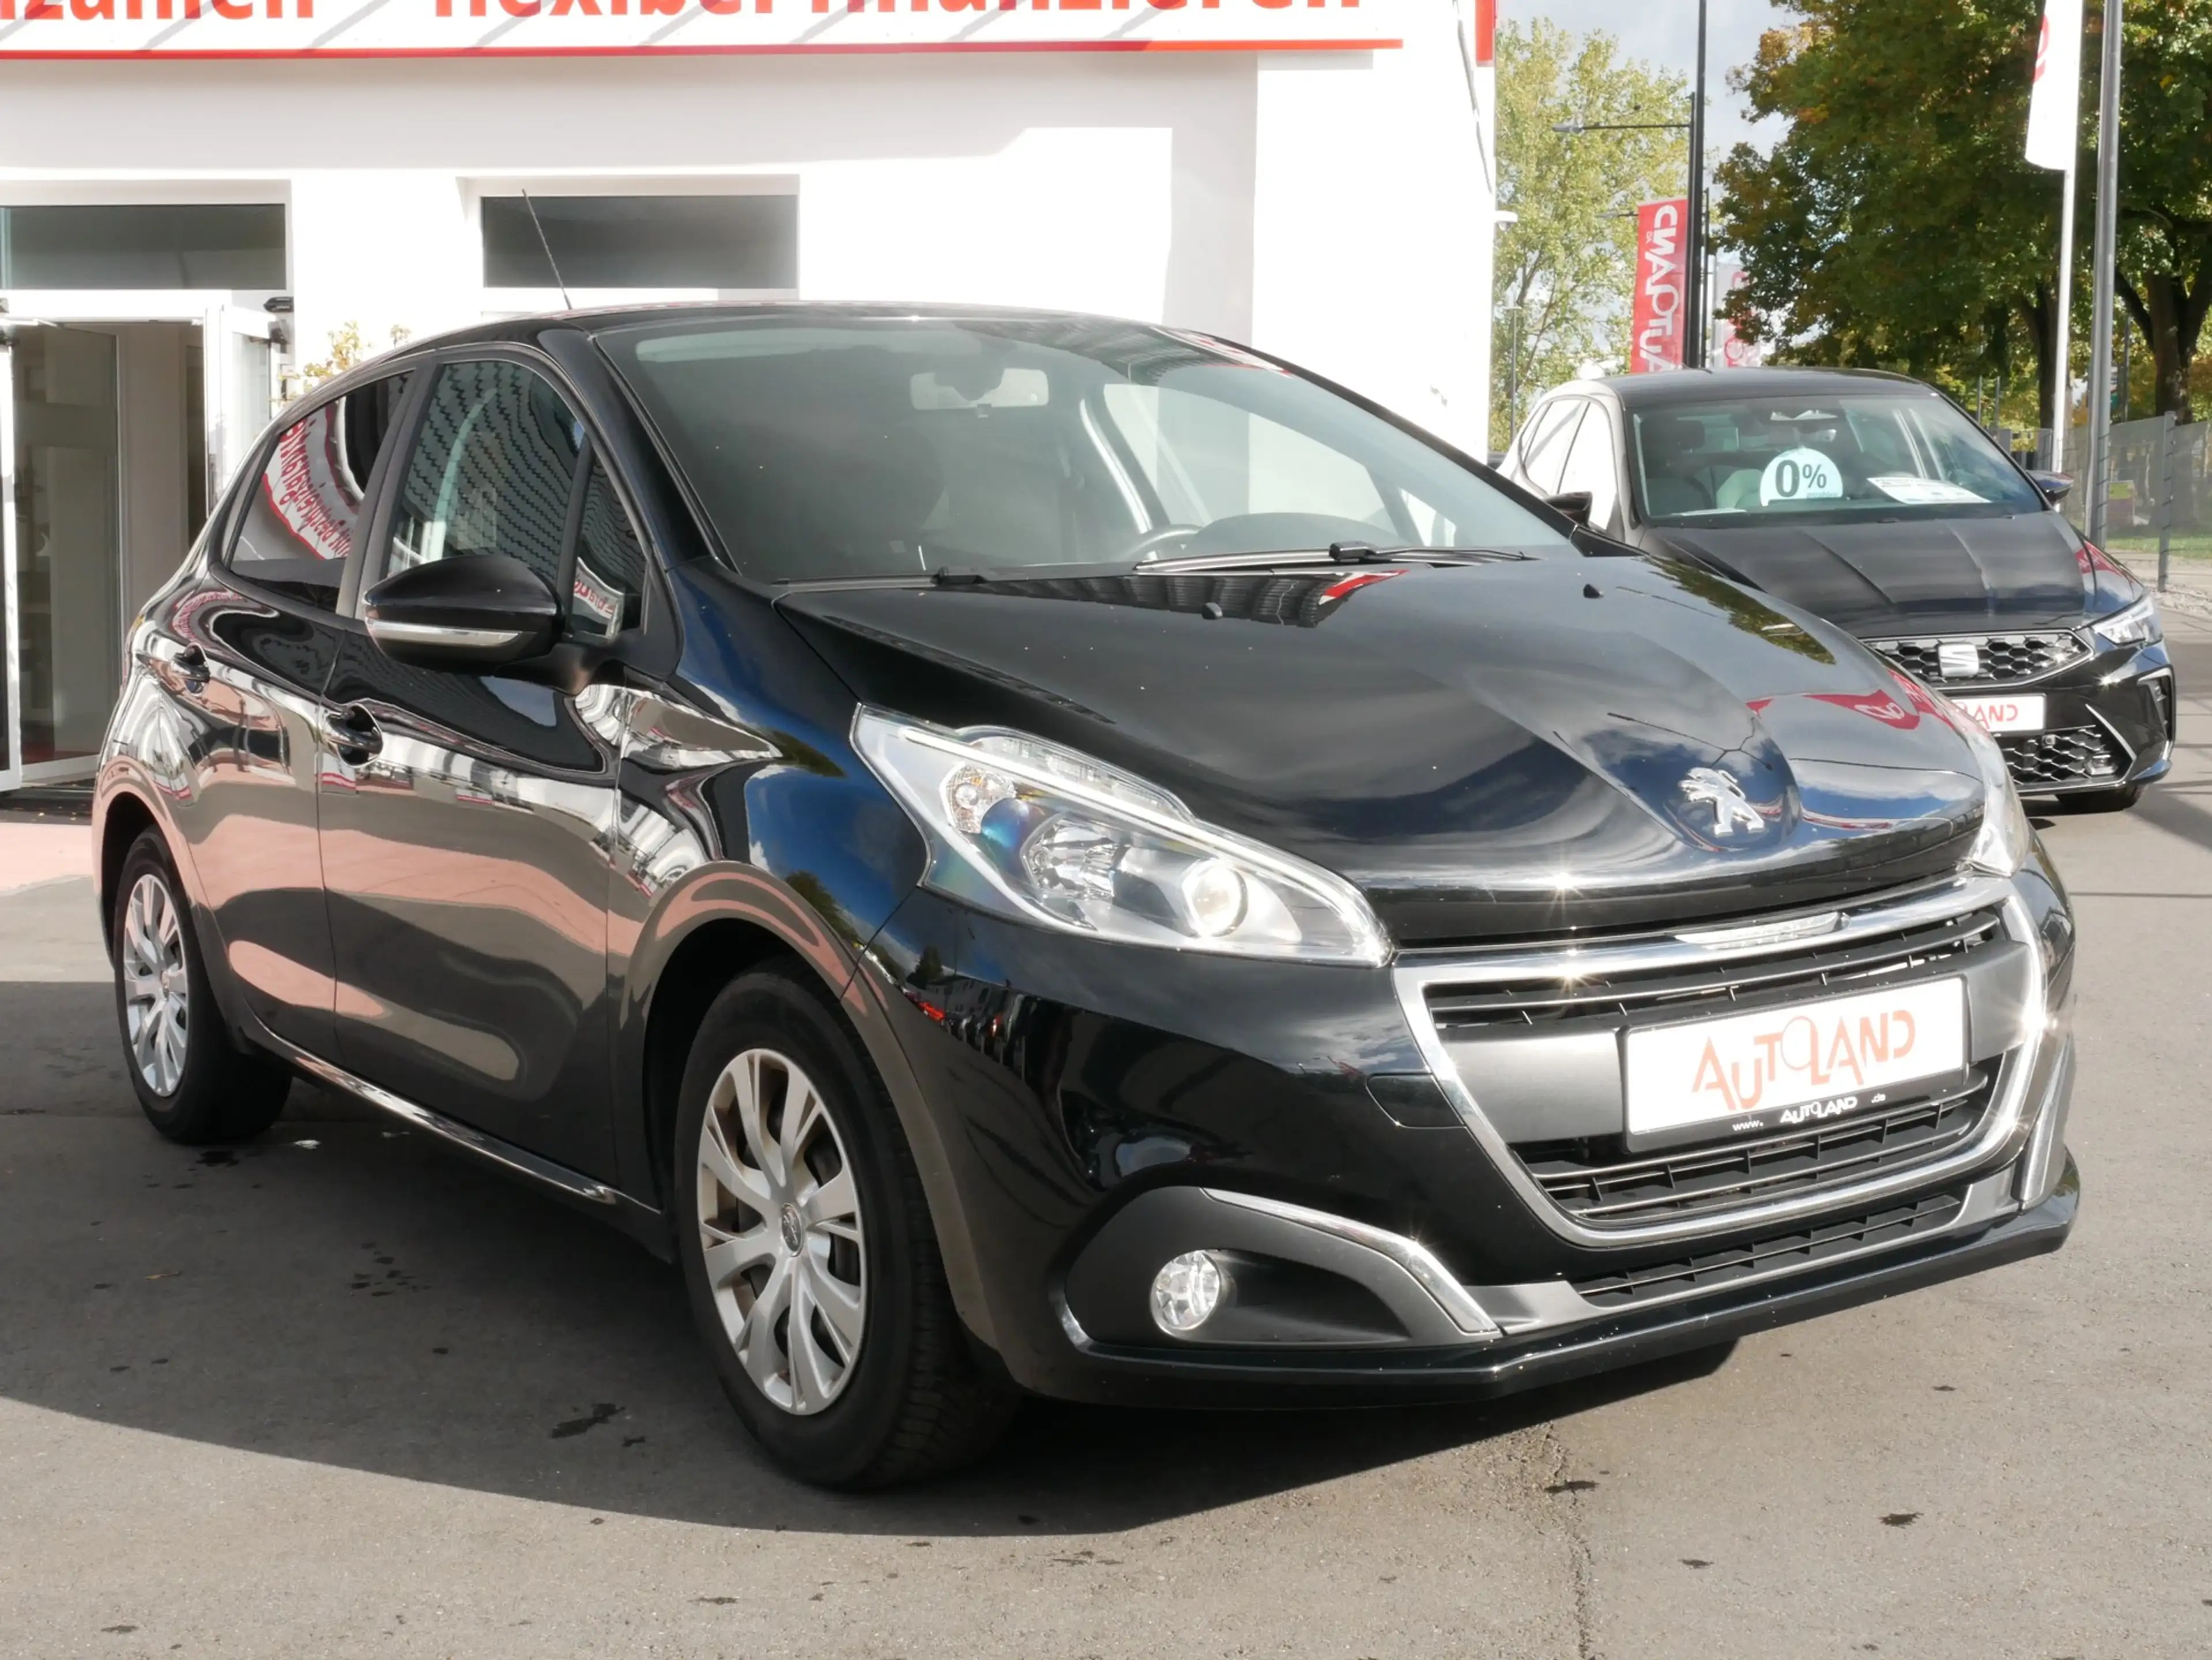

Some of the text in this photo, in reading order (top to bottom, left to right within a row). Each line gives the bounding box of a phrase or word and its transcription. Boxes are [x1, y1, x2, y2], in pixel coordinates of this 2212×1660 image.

[1775, 459, 1827, 497] 0%
[1691, 1009, 1915, 1110] AUTOLAND
[1732, 1119, 1764, 1131] www.
[1779, 1096, 1858, 1124] AUTOLAND
